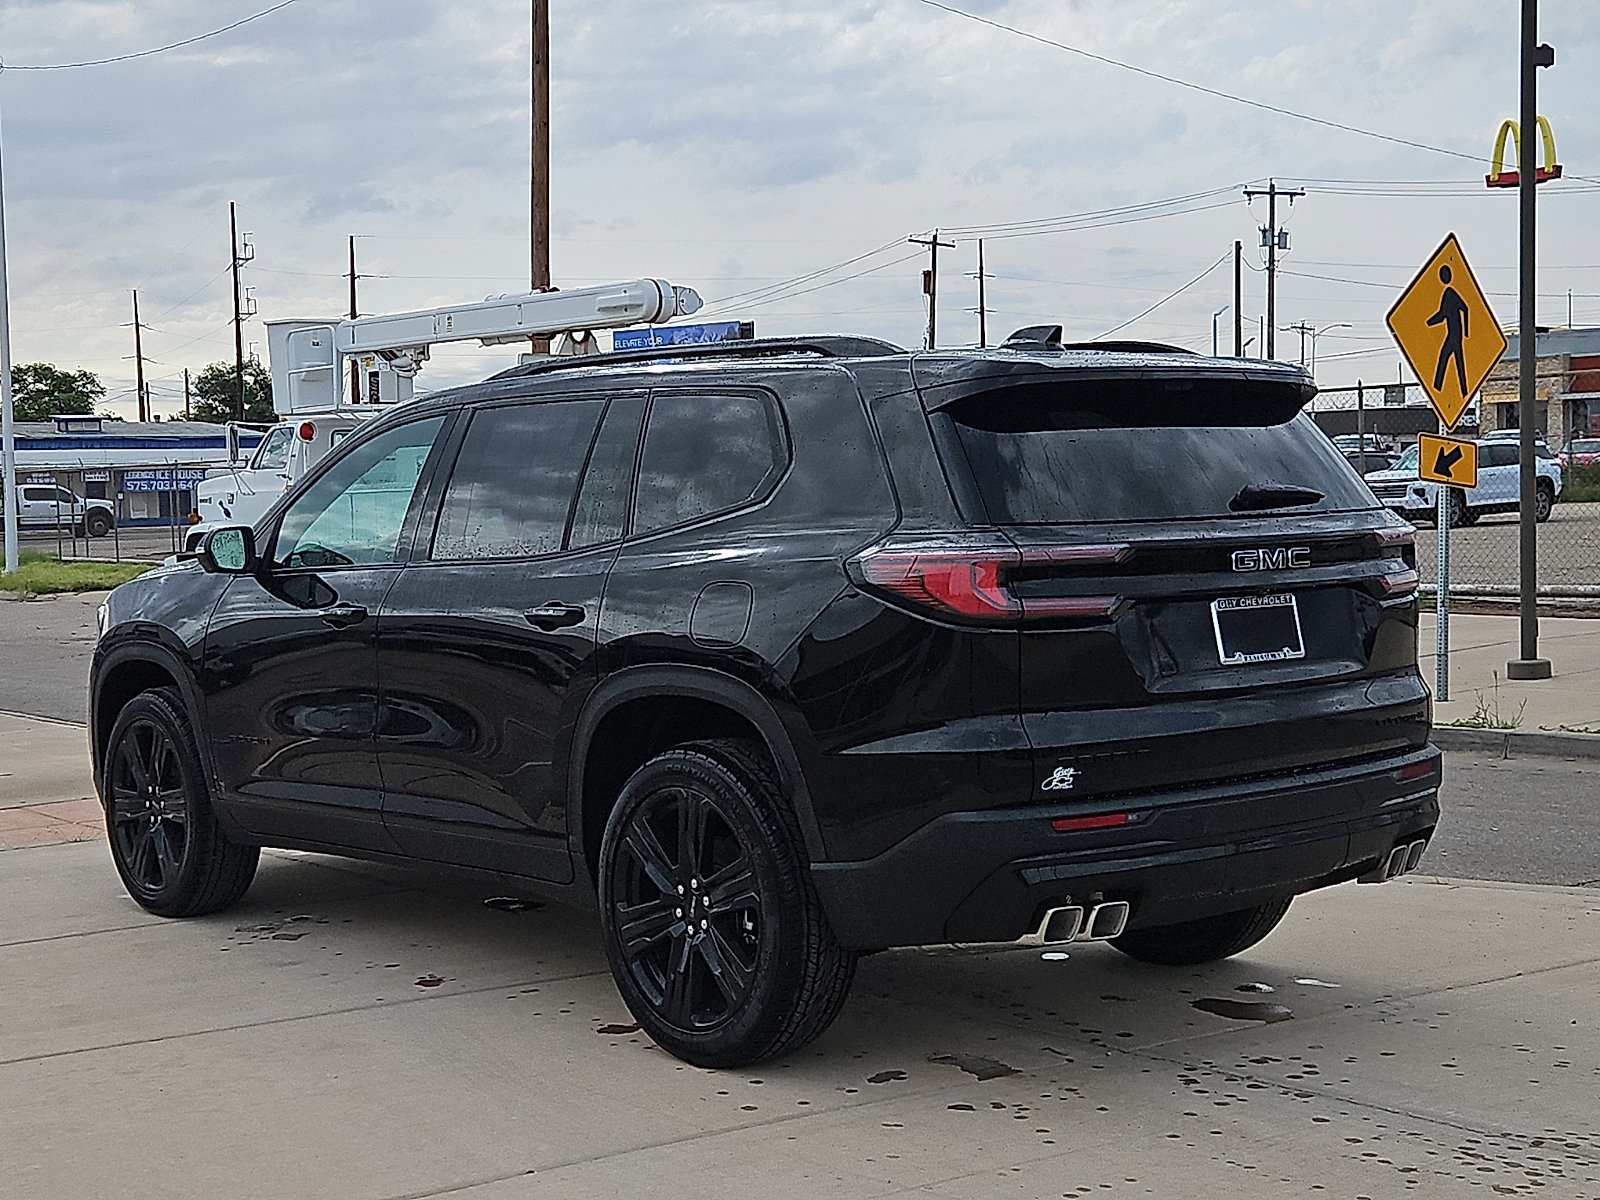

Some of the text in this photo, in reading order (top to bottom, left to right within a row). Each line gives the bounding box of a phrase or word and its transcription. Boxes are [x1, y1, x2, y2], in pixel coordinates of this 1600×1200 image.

[614, 337, 643, 349] ELEVATE
[155, 470, 171, 480] ICE
[1231, 547, 1310, 571] GMC
[1239, 595, 1291, 607] CHEVROLET
